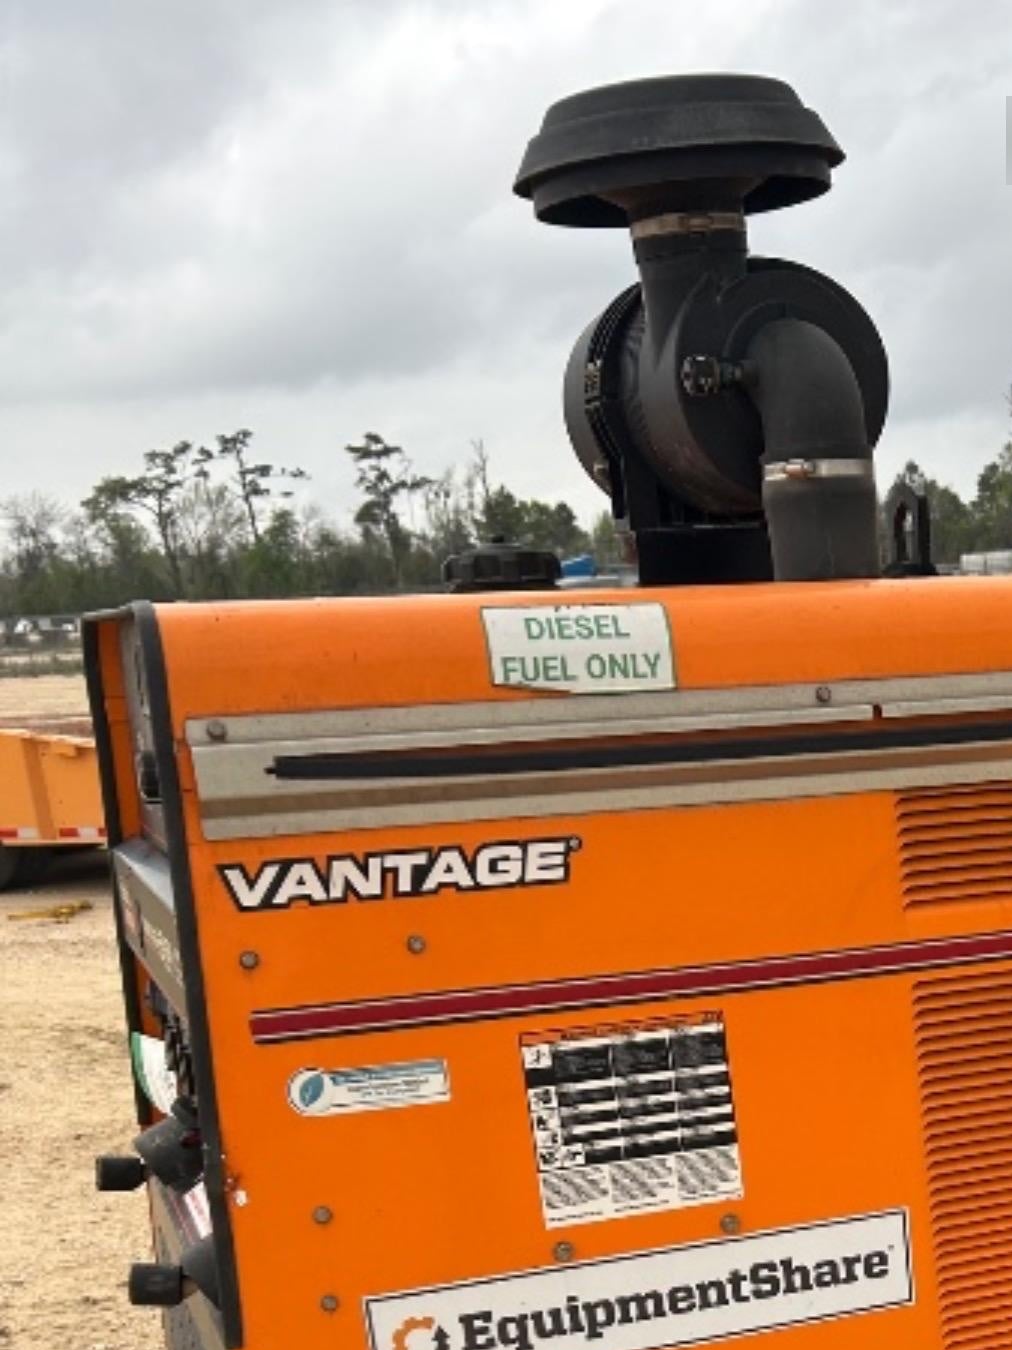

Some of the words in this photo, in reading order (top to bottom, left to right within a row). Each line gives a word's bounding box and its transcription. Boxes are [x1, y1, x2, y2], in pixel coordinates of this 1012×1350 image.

[524, 614, 631, 641] DIESEL
[501, 655, 579, 683] FUEL
[586, 652, 661, 680] ONLY
[220, 840, 569, 909] VANTAGE
